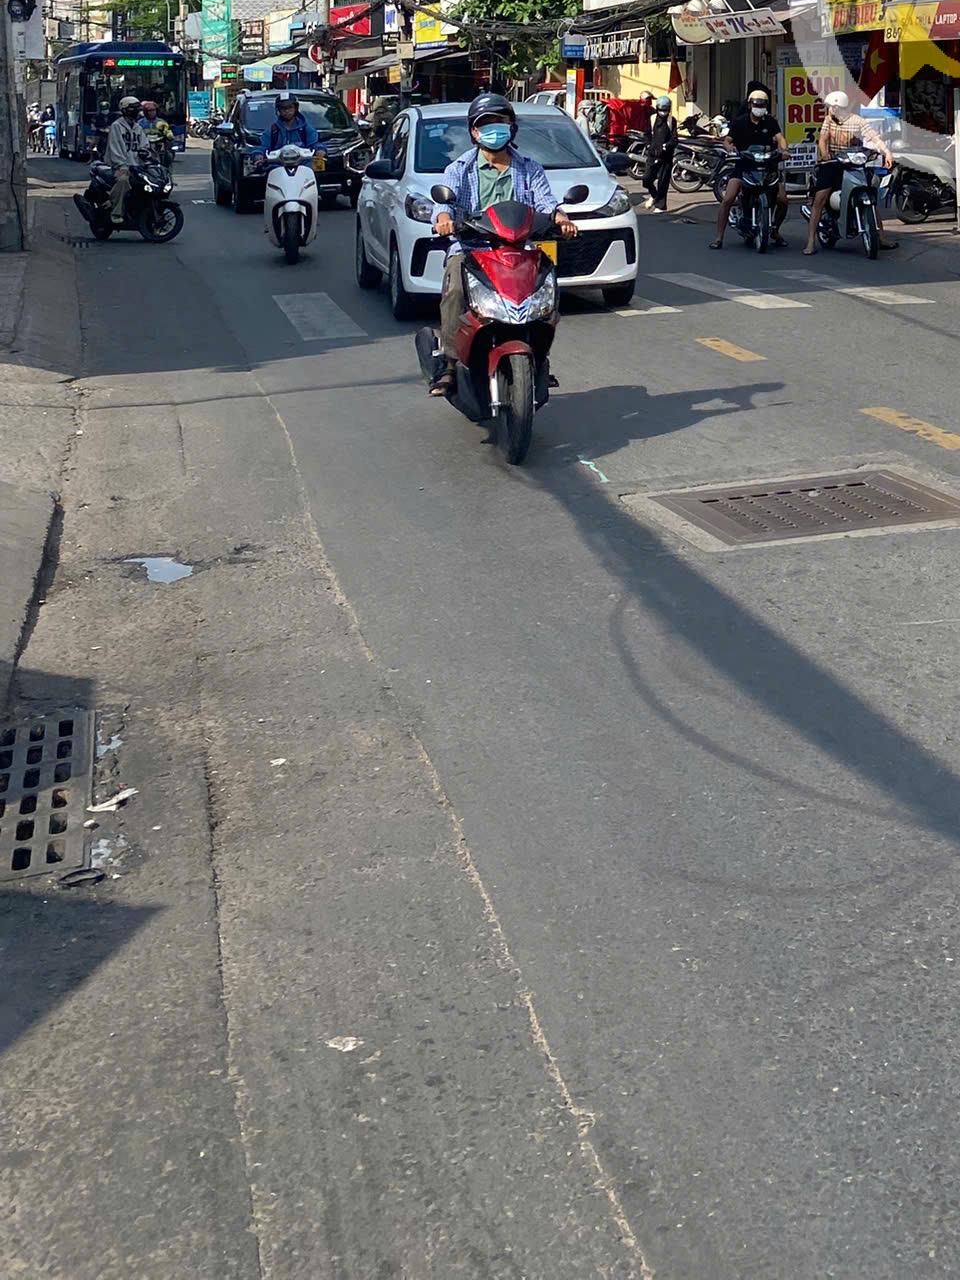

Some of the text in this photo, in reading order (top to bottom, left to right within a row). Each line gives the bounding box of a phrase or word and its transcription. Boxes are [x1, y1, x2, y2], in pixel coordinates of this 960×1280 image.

[935, 15, 957, 25] LAPTOP
[790, 70, 840, 96] BÚN
[788, 98, 828, 123] RIÊ
